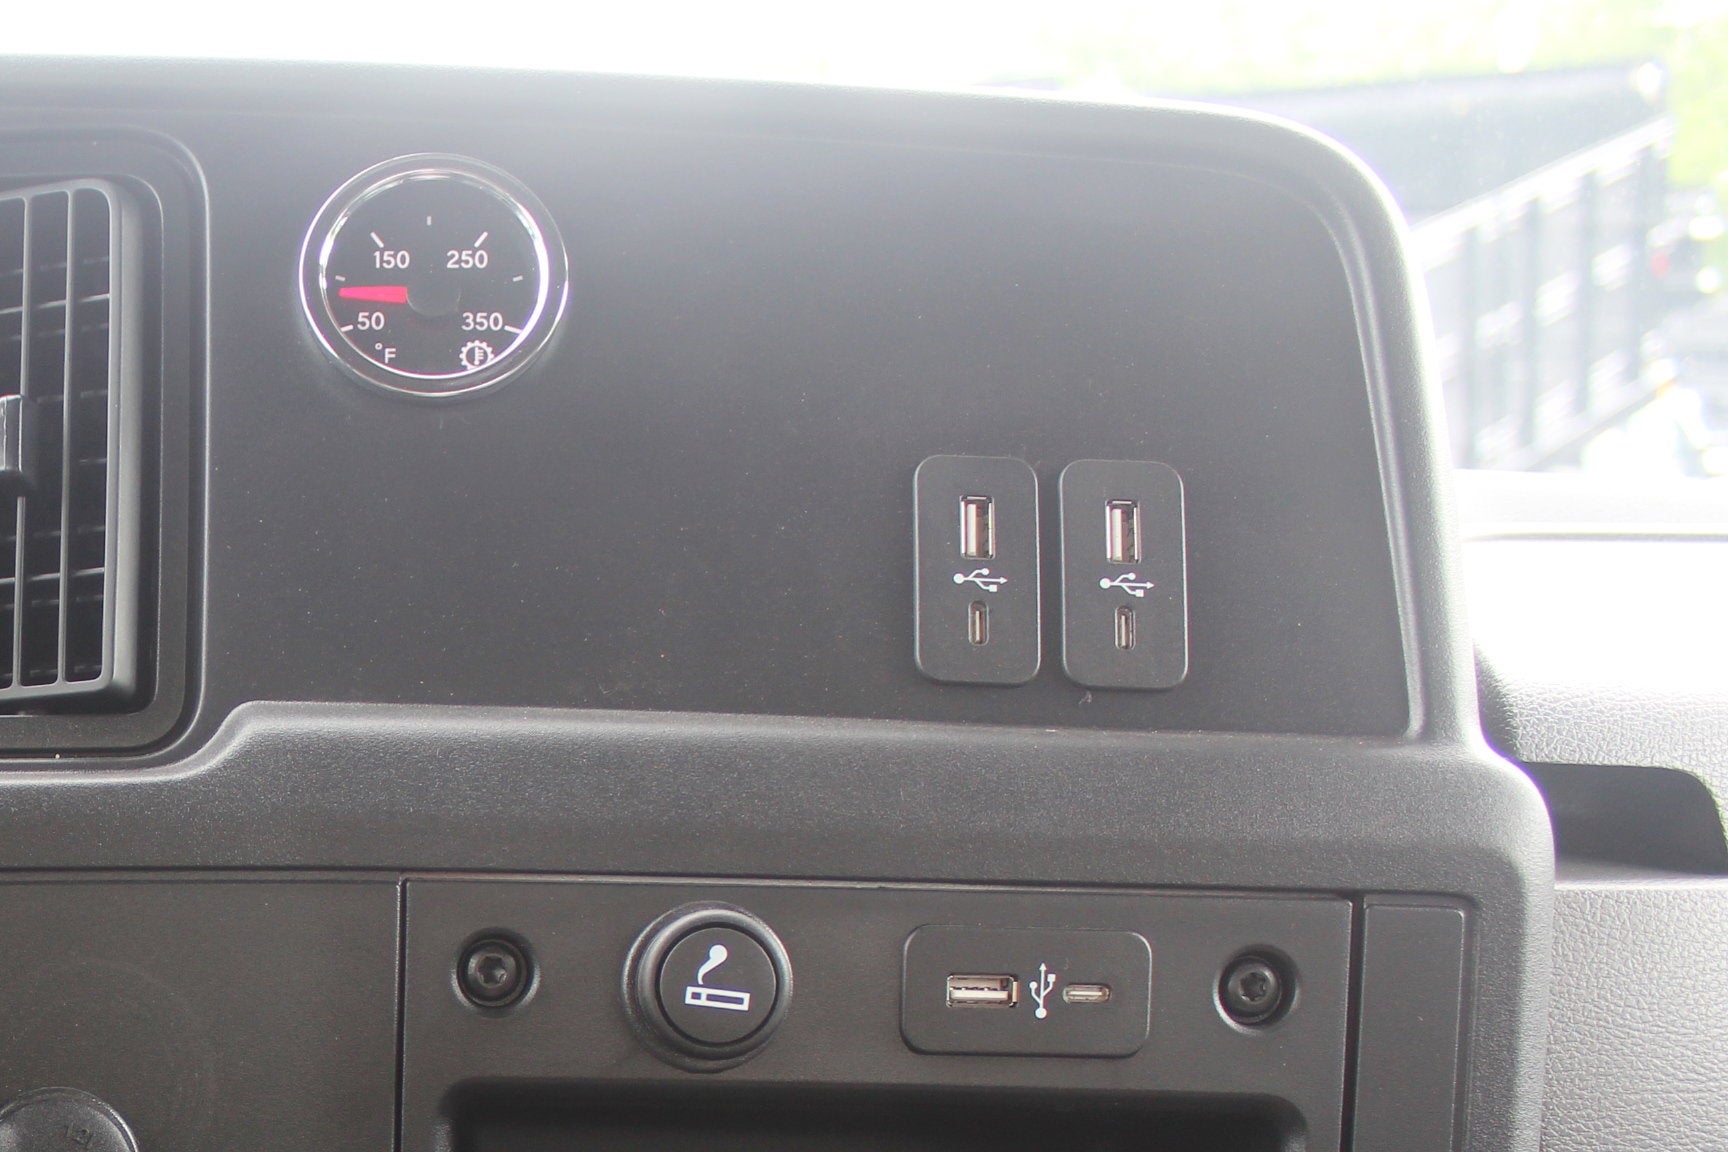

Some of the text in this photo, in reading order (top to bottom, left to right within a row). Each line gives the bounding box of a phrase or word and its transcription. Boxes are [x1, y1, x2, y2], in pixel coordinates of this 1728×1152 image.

[373, 250, 410, 269] 150
[446, 249, 488, 269] 250
[357, 311, 385, 331] 50
[460, 312, 504, 331] 350
